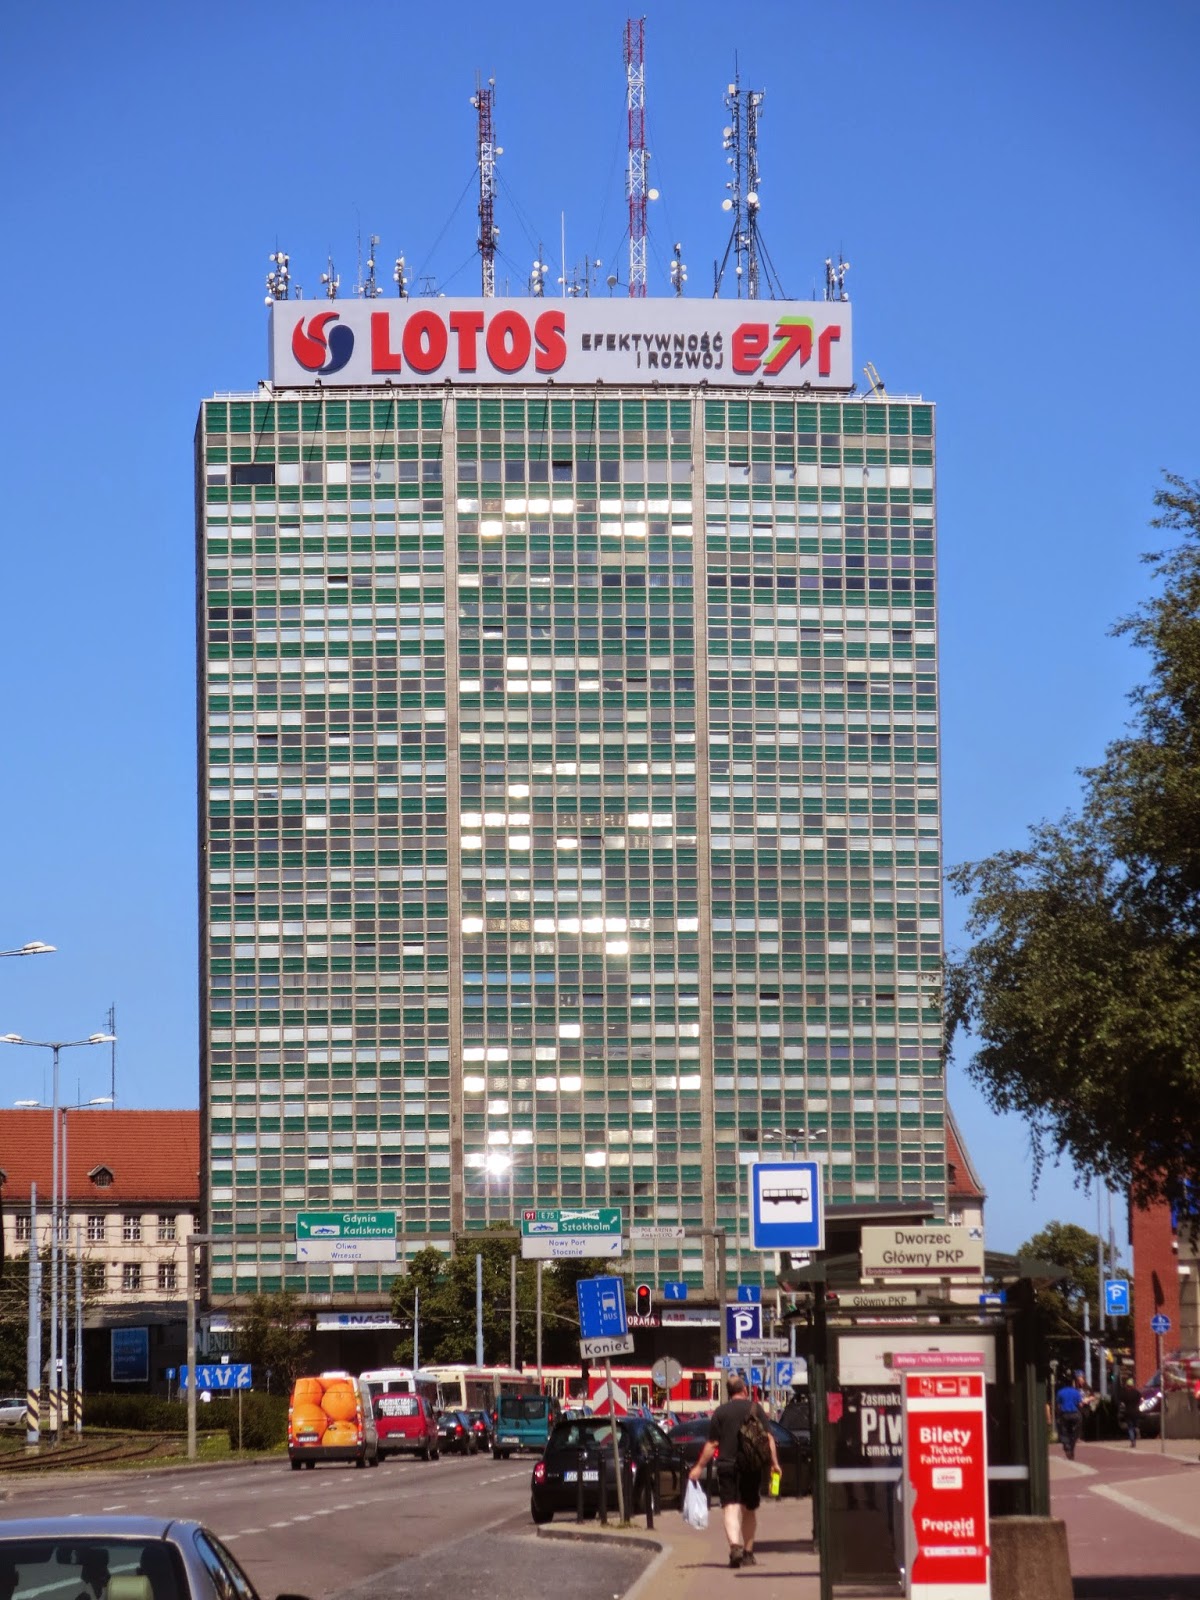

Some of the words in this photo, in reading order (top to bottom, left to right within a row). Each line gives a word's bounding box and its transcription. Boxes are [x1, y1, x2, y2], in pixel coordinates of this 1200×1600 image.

[371, 310, 567, 374] LOTOS
[581, 331, 723, 351] EFEKTYWNOŚĆ
[636, 351, 641, 369] I
[648, 350, 724, 369] ROZWÓJ
[342, 1214, 377, 1225] Gdynia
[343, 1226, 394, 1235] Karlskrona
[562, 1223, 611, 1231] Sztokholm
[895, 1231, 951, 1245] Dworzec
[882, 1250, 932, 1266] Główny
[936, 1250, 964, 1263] PKP
[853, 1296, 887, 1306] Główny
[888, 1296, 907, 1306] PKP
[603, 1312, 618, 1321] BUS
[584, 1340, 630, 1356] Koniec
[920, 1427, 971, 1447] Bilety
[866, 1444, 890, 1456] smak
[929, 1445, 963, 1455] Tickets
[920, 1455, 972, 1465] Fahrkarten
[921, 1517, 975, 1534] Prepaid
[953, 1529, 975, 1538] GSM
